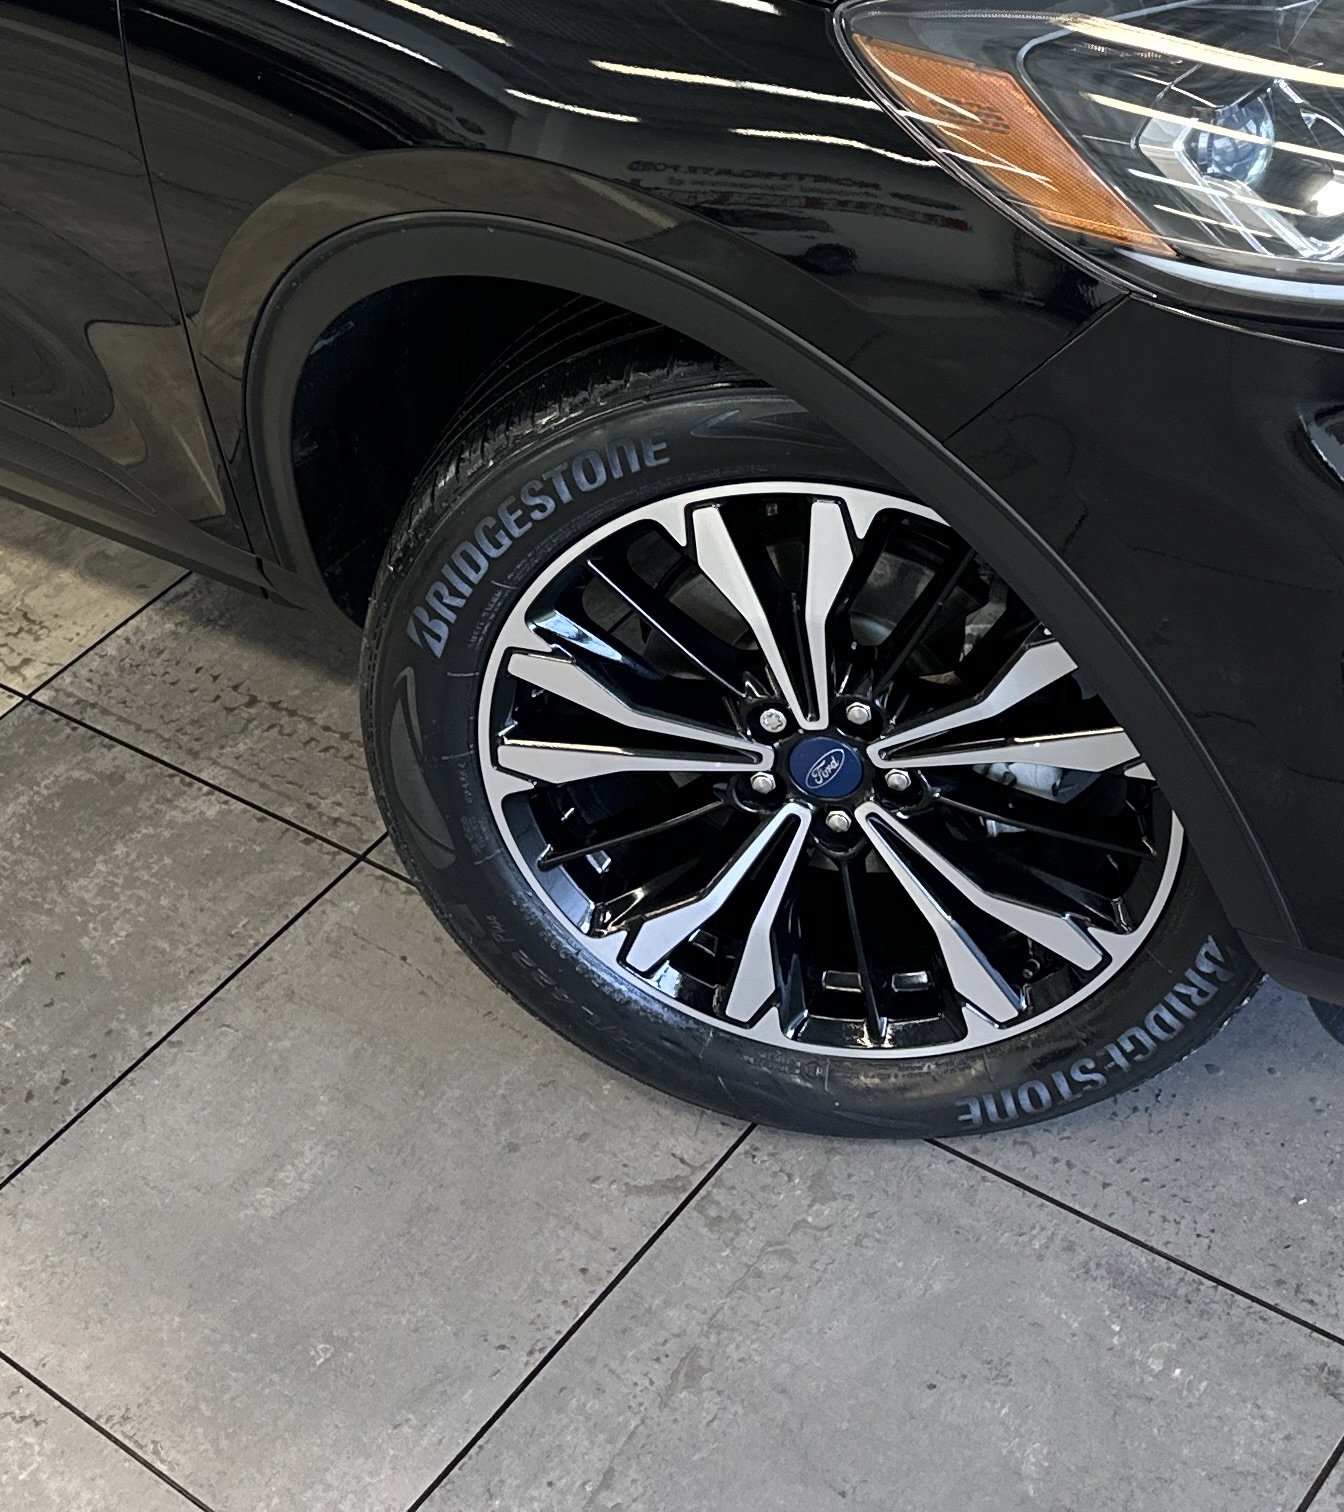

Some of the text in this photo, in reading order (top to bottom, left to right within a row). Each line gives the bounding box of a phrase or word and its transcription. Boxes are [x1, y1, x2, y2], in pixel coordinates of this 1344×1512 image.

[407, 439, 671, 659] BRIDGESTONE
[811, 755, 840, 785] Ford
[957, 934, 1234, 1129] BRIDGESTONE
